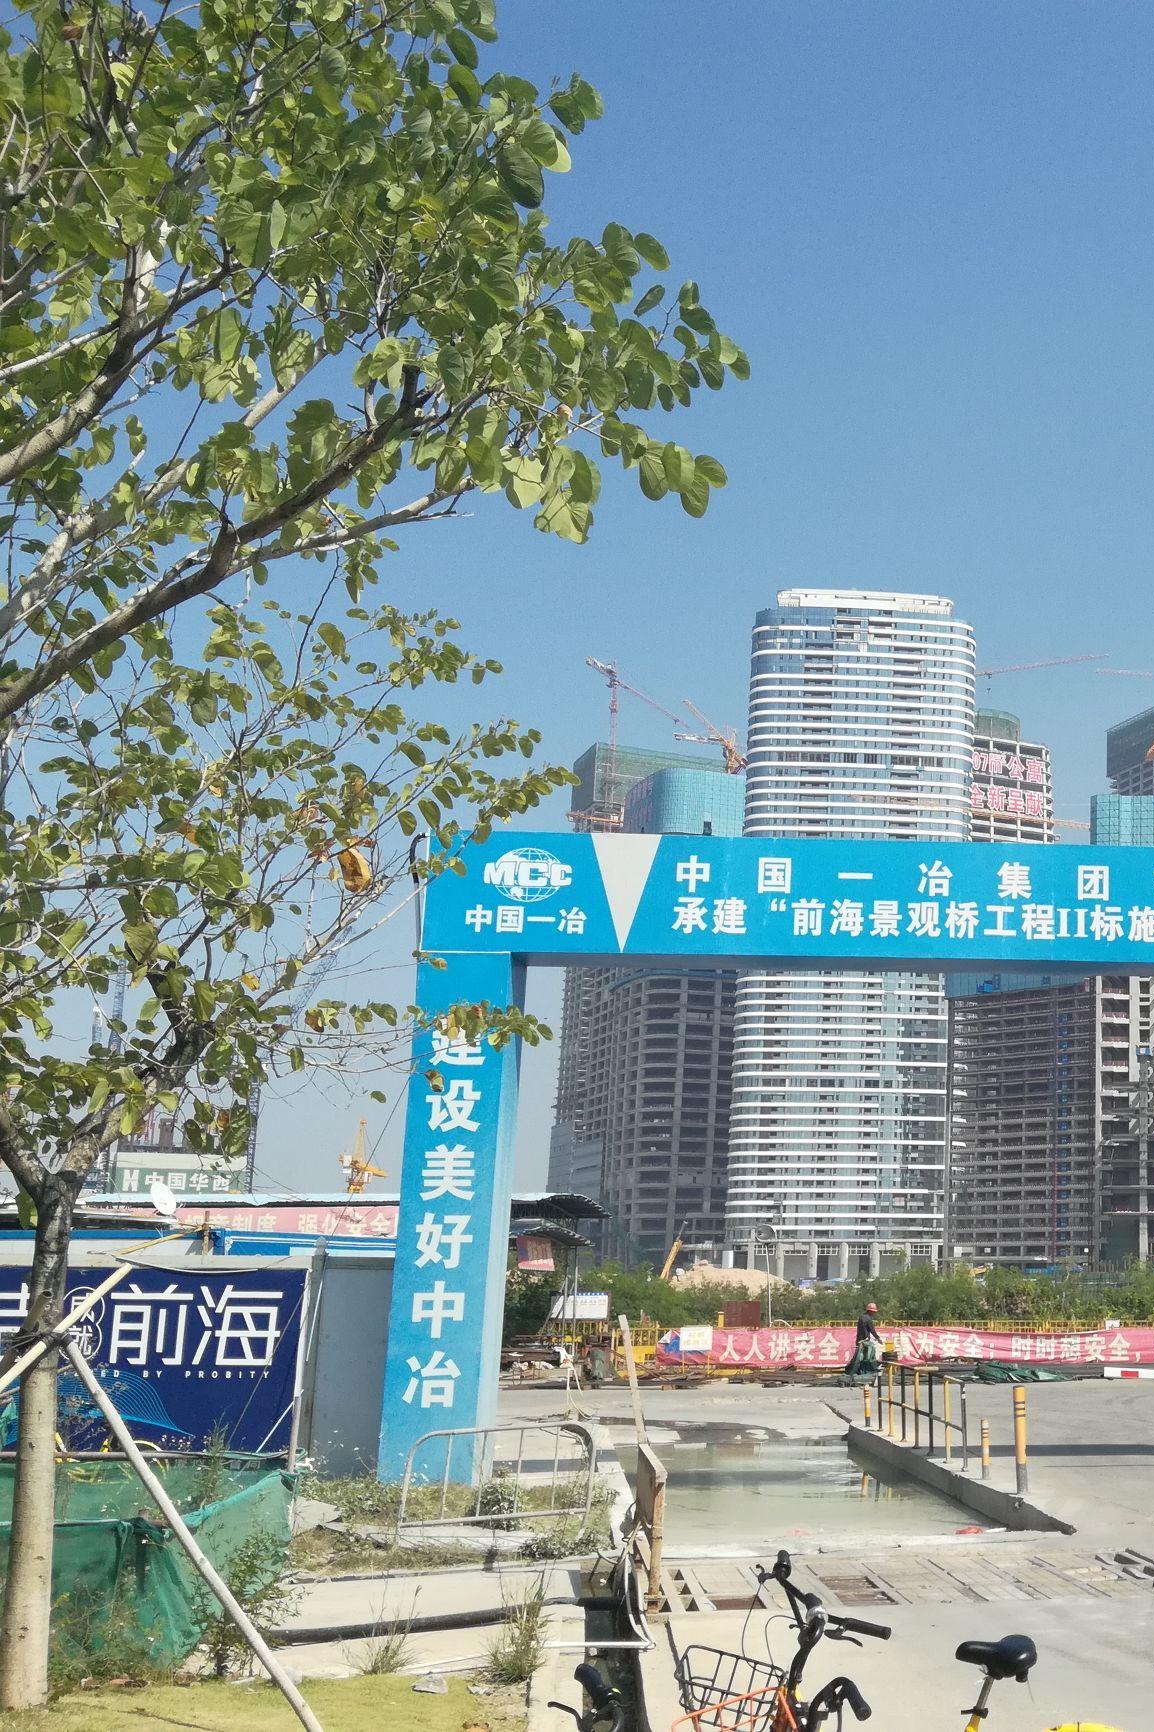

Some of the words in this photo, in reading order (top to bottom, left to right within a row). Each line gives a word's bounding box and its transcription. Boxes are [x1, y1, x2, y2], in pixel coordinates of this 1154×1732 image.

[483, 860, 573, 888] MCC
[464, 905, 588, 935] 中国一冶
[402, 1015, 486, 1409] 建设美好中冶
[109, 1284, 284, 1366] 前海
[142, 1370, 163, 1379] BY
[185, 1370, 270, 1379] PROBITY
